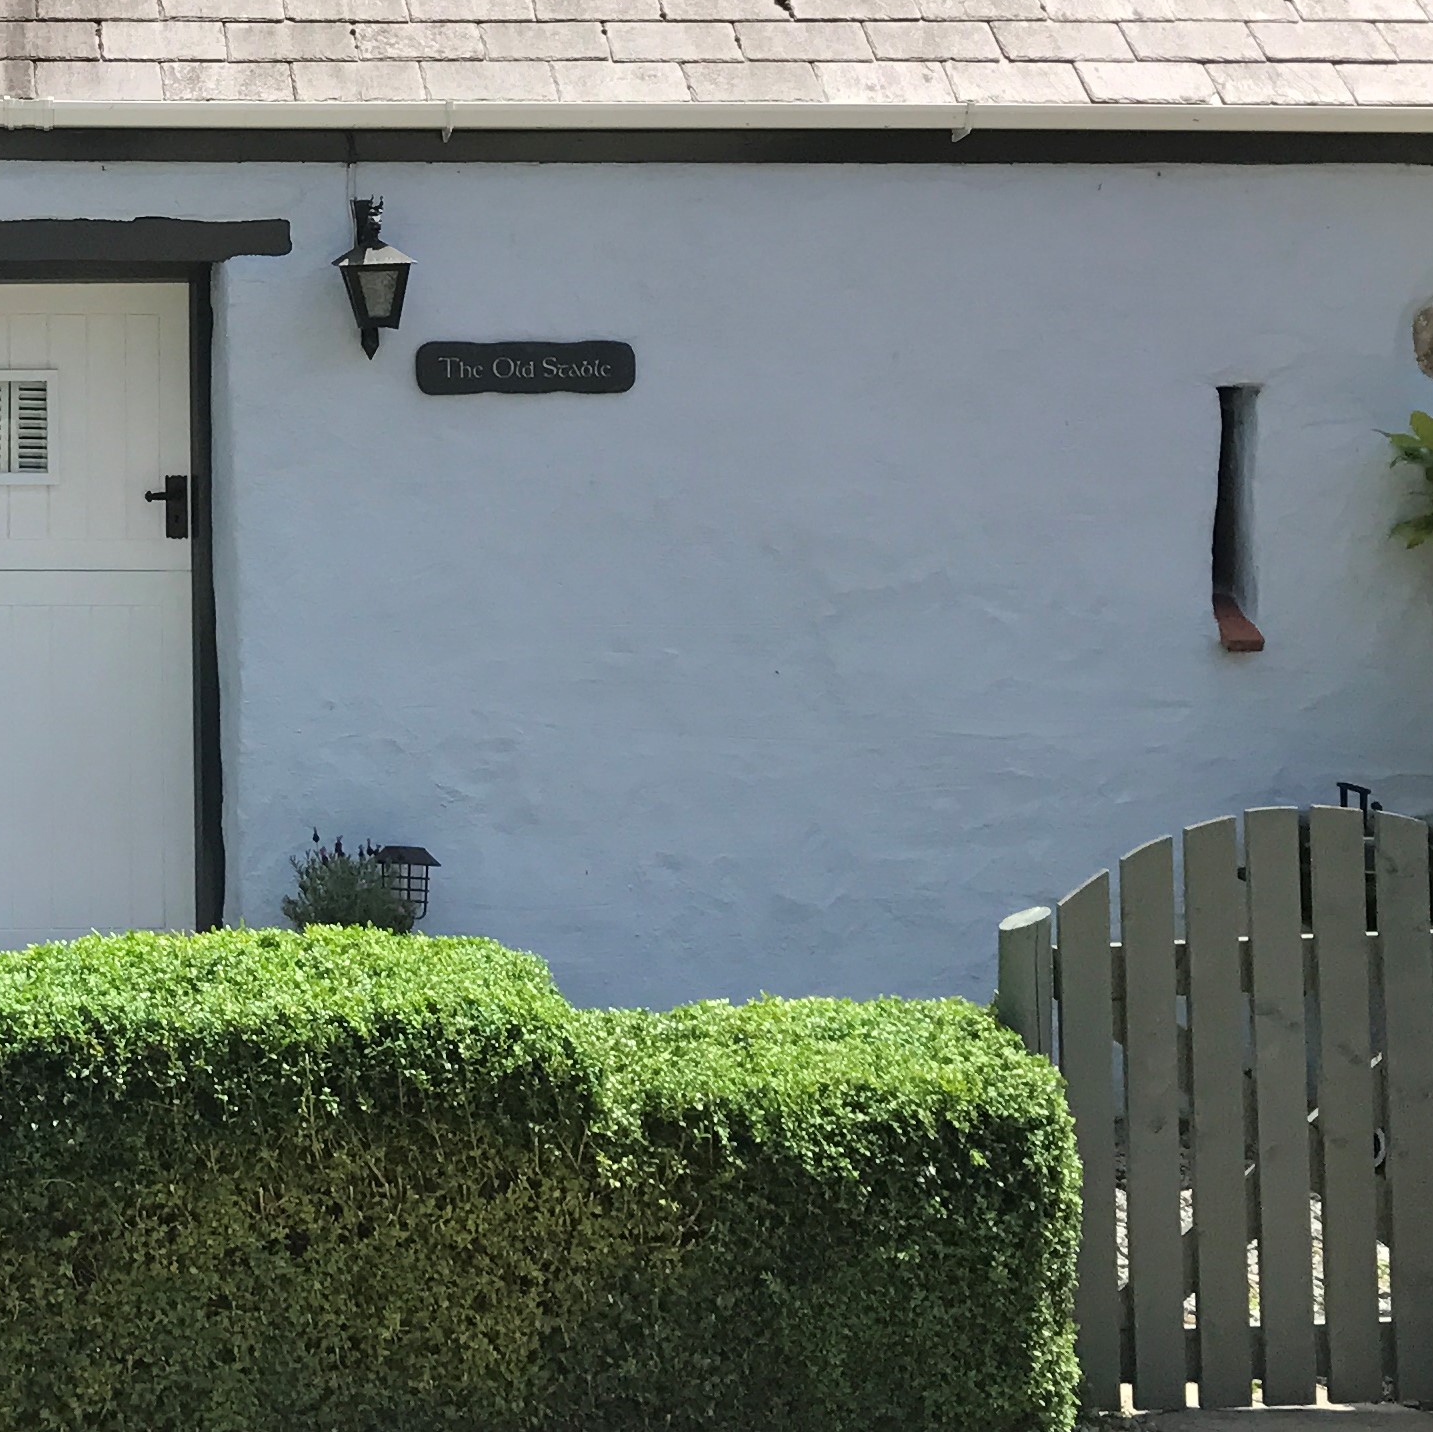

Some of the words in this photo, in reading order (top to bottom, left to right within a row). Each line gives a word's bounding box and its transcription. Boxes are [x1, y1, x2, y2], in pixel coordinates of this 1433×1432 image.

[438, 357, 484, 379] The
[492, 356, 535, 379] Old
[542, 356, 612, 379] Stable
